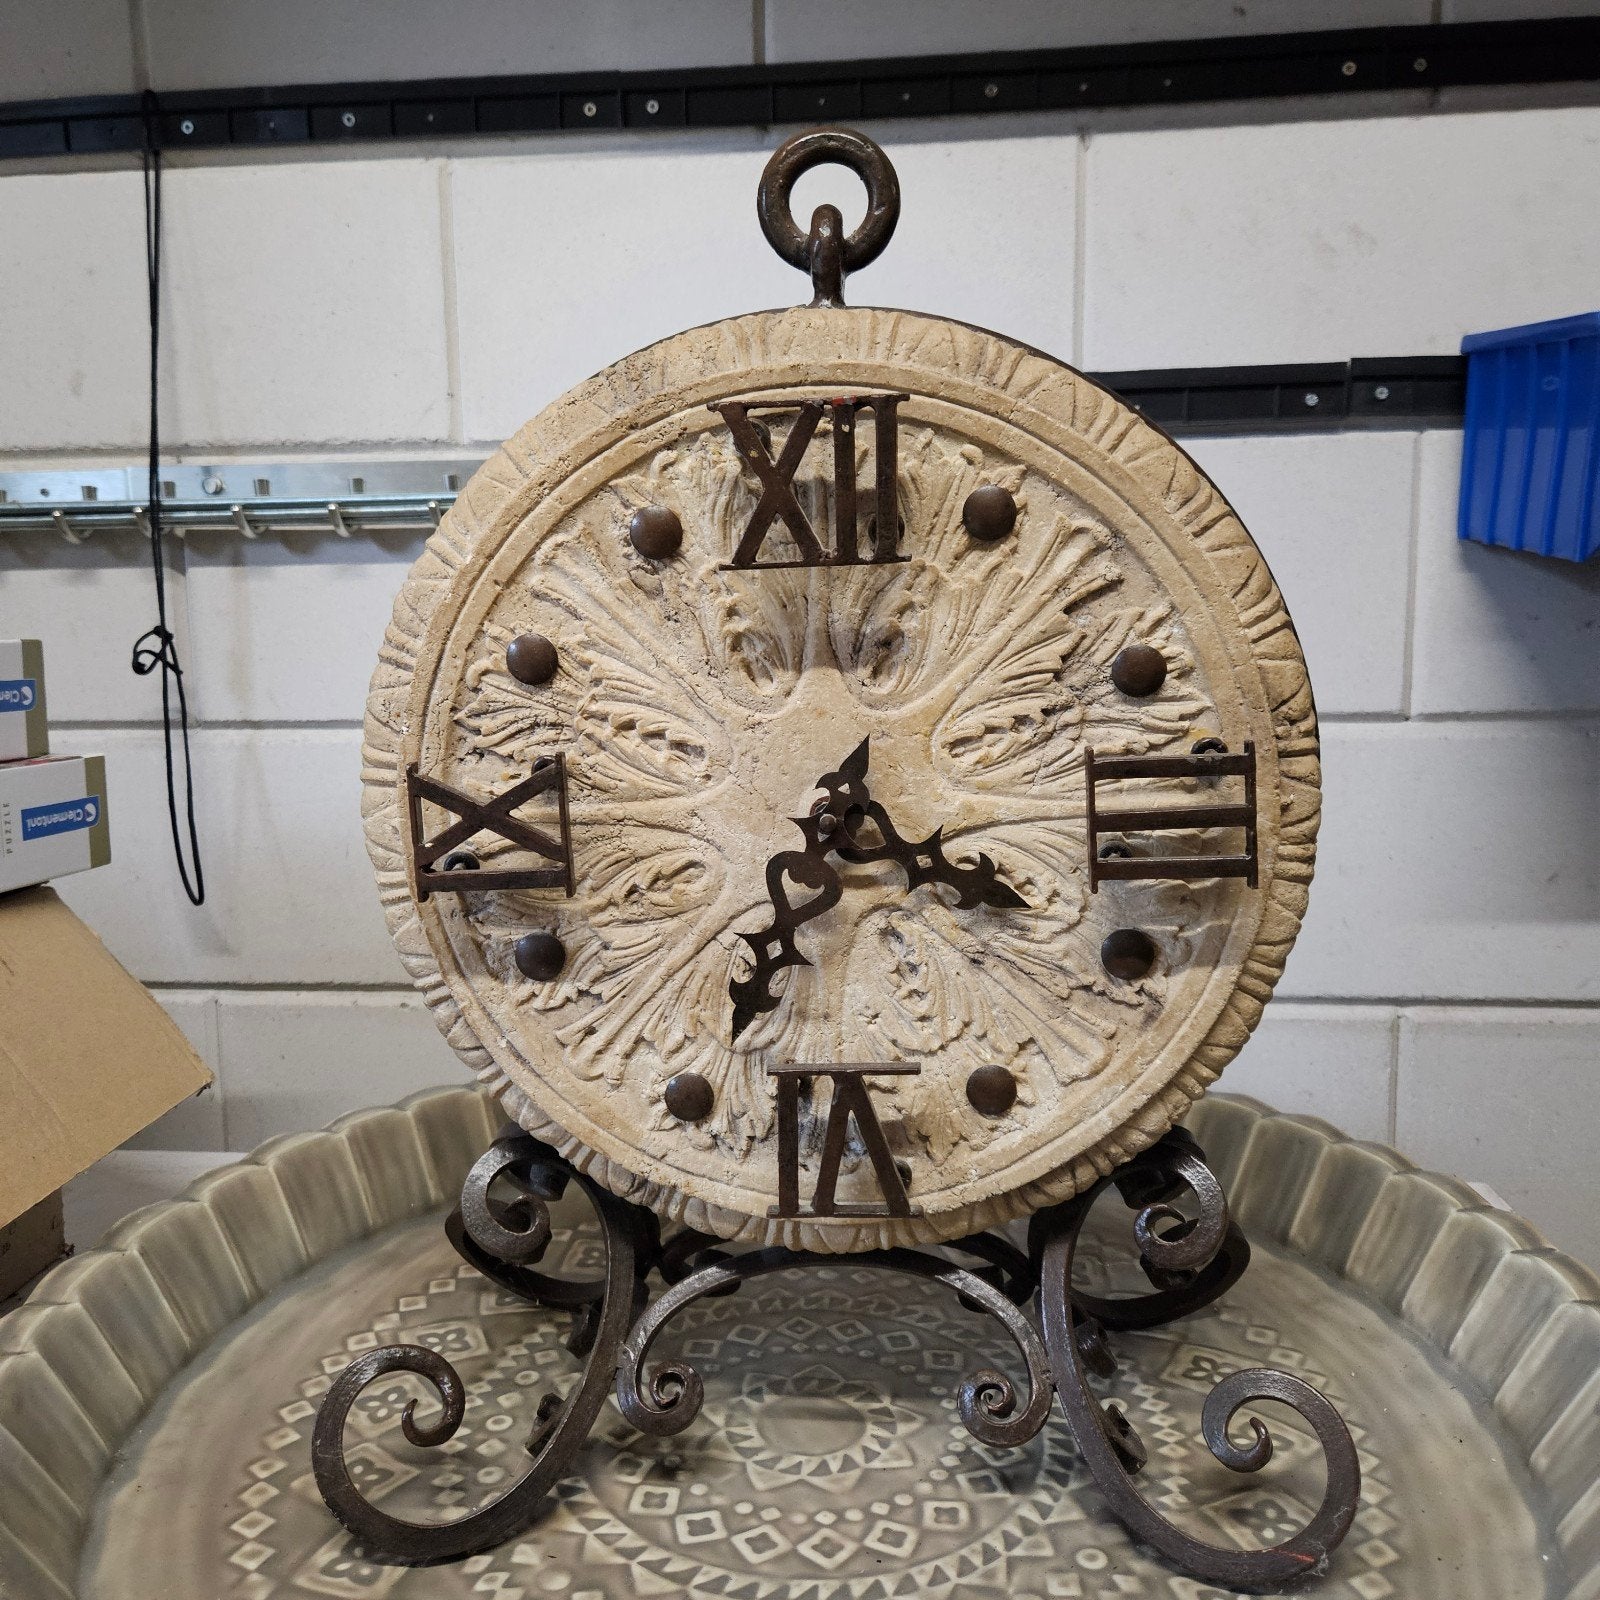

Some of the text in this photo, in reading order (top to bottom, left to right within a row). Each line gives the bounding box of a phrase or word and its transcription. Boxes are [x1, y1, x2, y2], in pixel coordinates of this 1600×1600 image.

[707, 394, 912, 571] XII
[3, 802, 13, 854] PUZZLE
[26, 808, 83, 831] Clementoni
[1084, 740, 1259, 894] III
